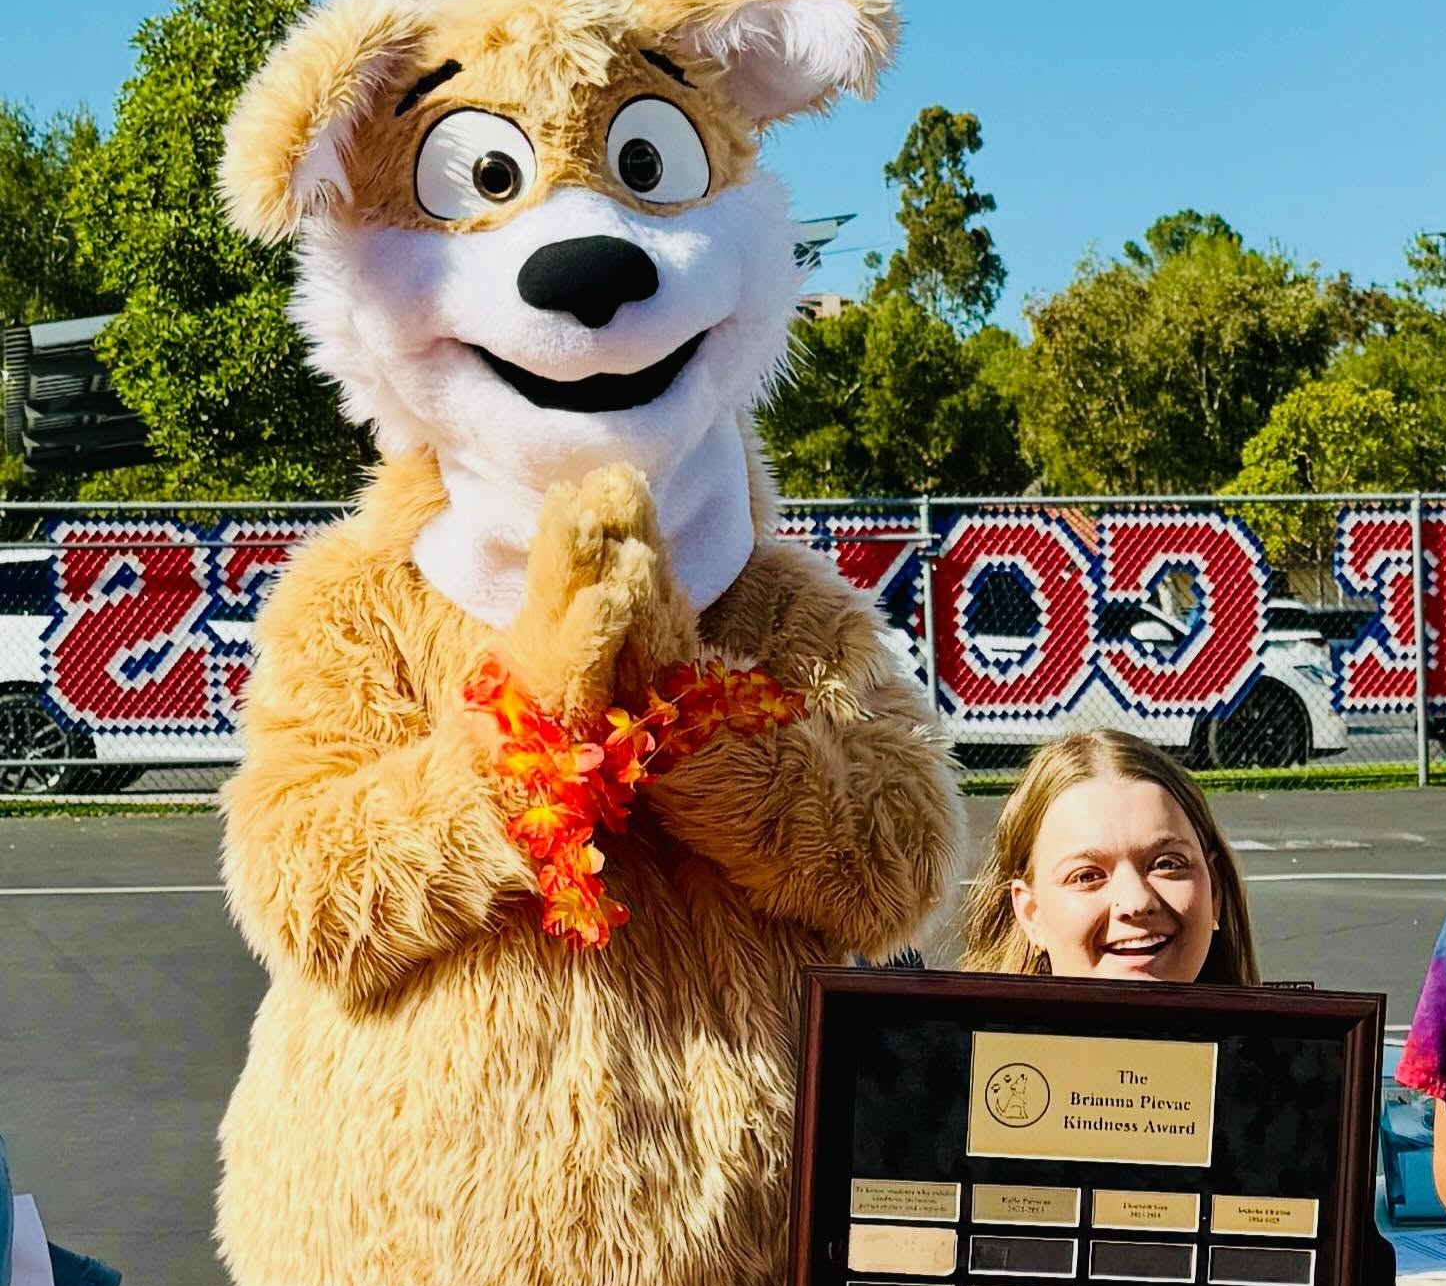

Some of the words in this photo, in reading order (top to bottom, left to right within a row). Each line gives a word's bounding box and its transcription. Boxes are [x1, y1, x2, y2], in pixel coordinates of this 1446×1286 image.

[1117, 1070, 1148, 1085] The
[1070, 1091, 1134, 1108] Brianna
[1064, 1115, 1138, 1132] Kindness
[1143, 1119, 1195, 1135] Award
